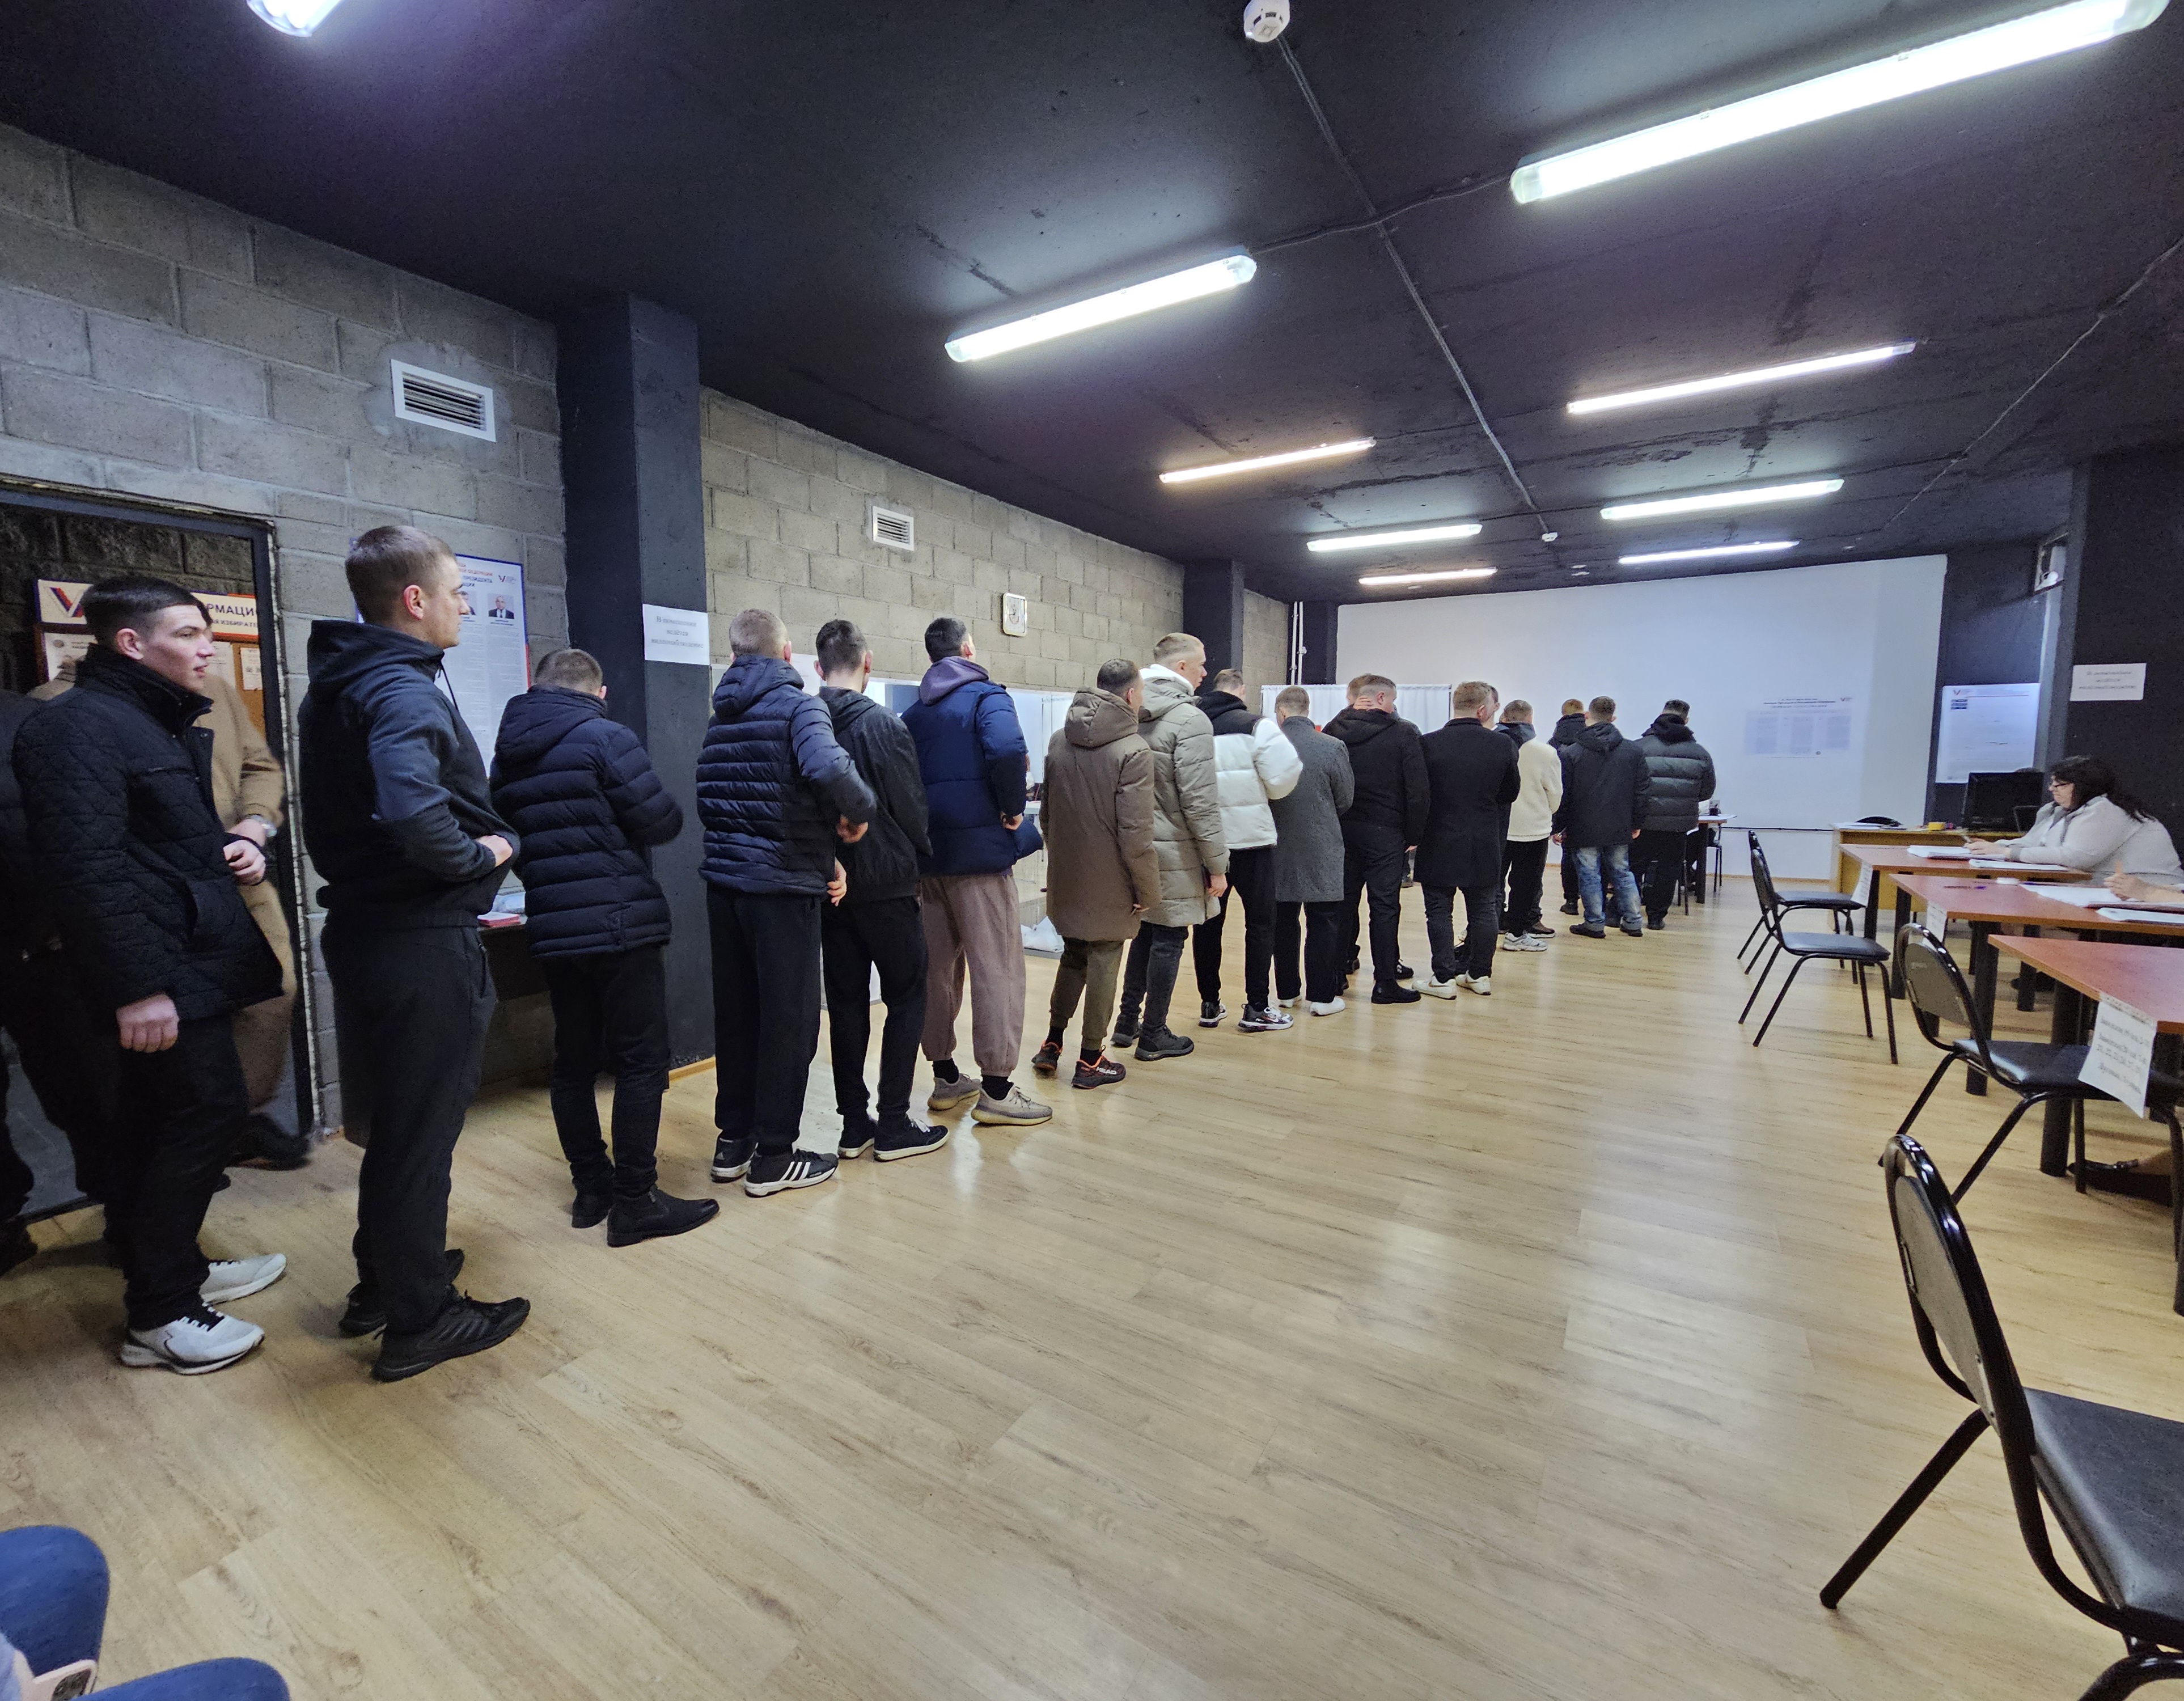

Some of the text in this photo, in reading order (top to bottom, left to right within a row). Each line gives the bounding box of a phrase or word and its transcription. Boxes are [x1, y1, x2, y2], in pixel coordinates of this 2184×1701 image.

[206, 603, 254, 617] РМАЦИ
[221, 619, 258, 628] ИЗБИРАТЕ
[1096, 1067, 1117, 1075] HEAD
